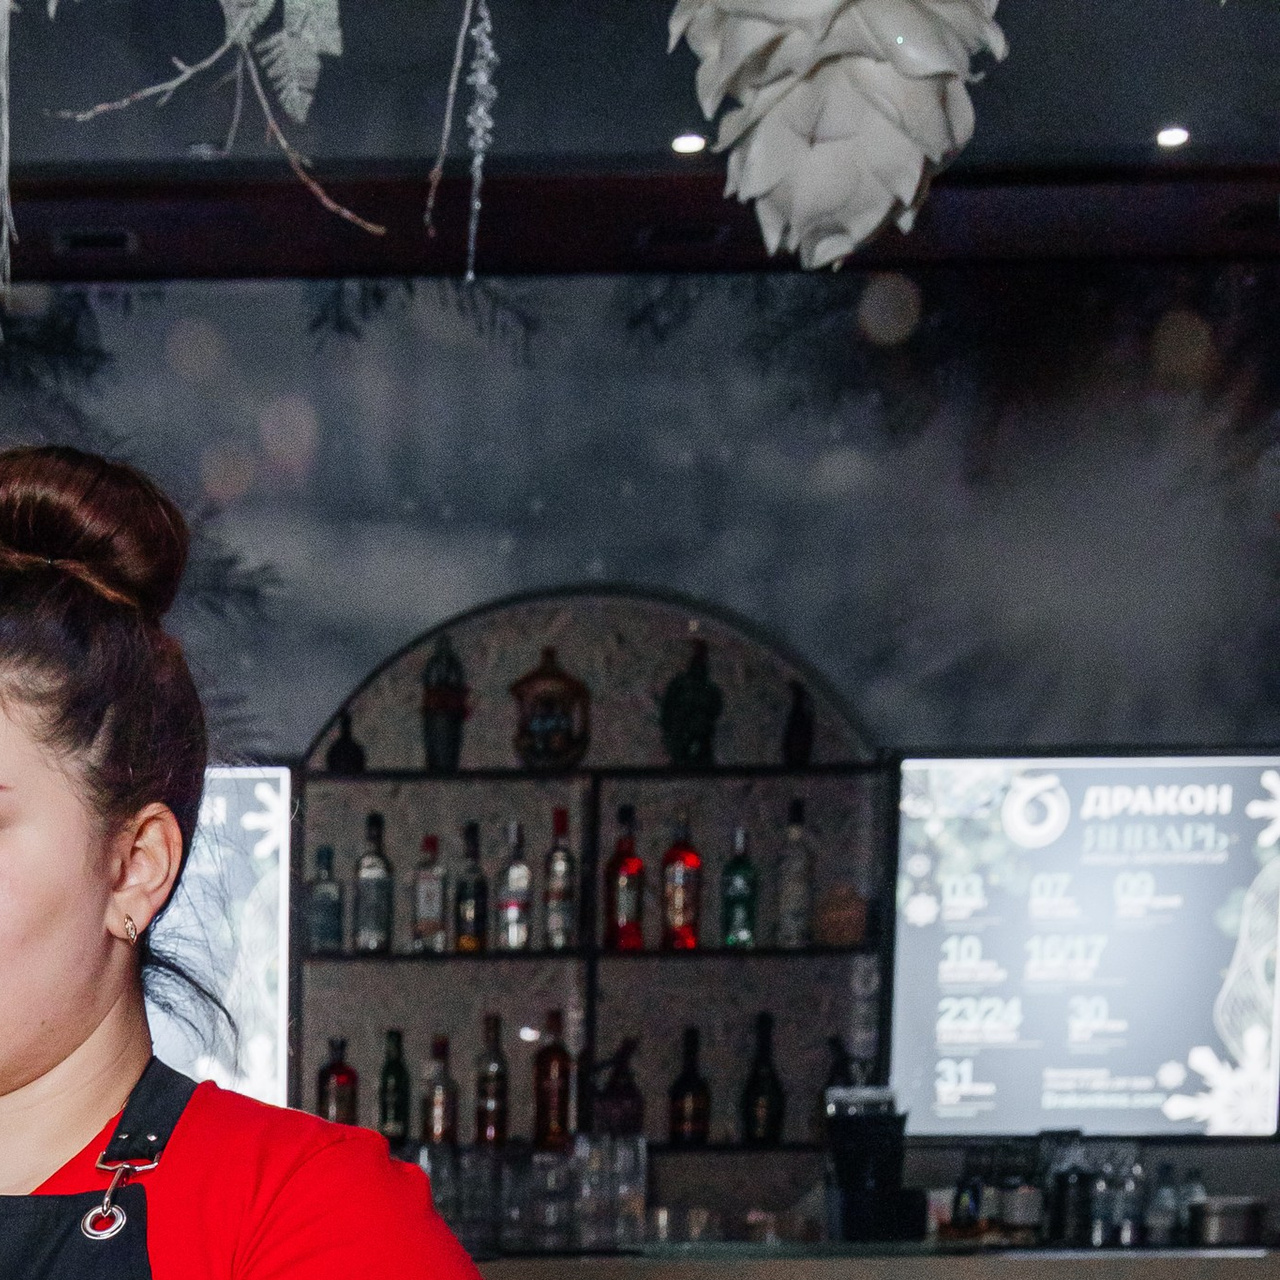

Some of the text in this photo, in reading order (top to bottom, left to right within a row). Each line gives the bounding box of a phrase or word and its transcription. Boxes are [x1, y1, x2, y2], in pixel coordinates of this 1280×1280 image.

[1080, 784, 1233, 820] ДРАКОН
[940, 934, 982, 963] 10
[935, 1058, 974, 1087] 31
